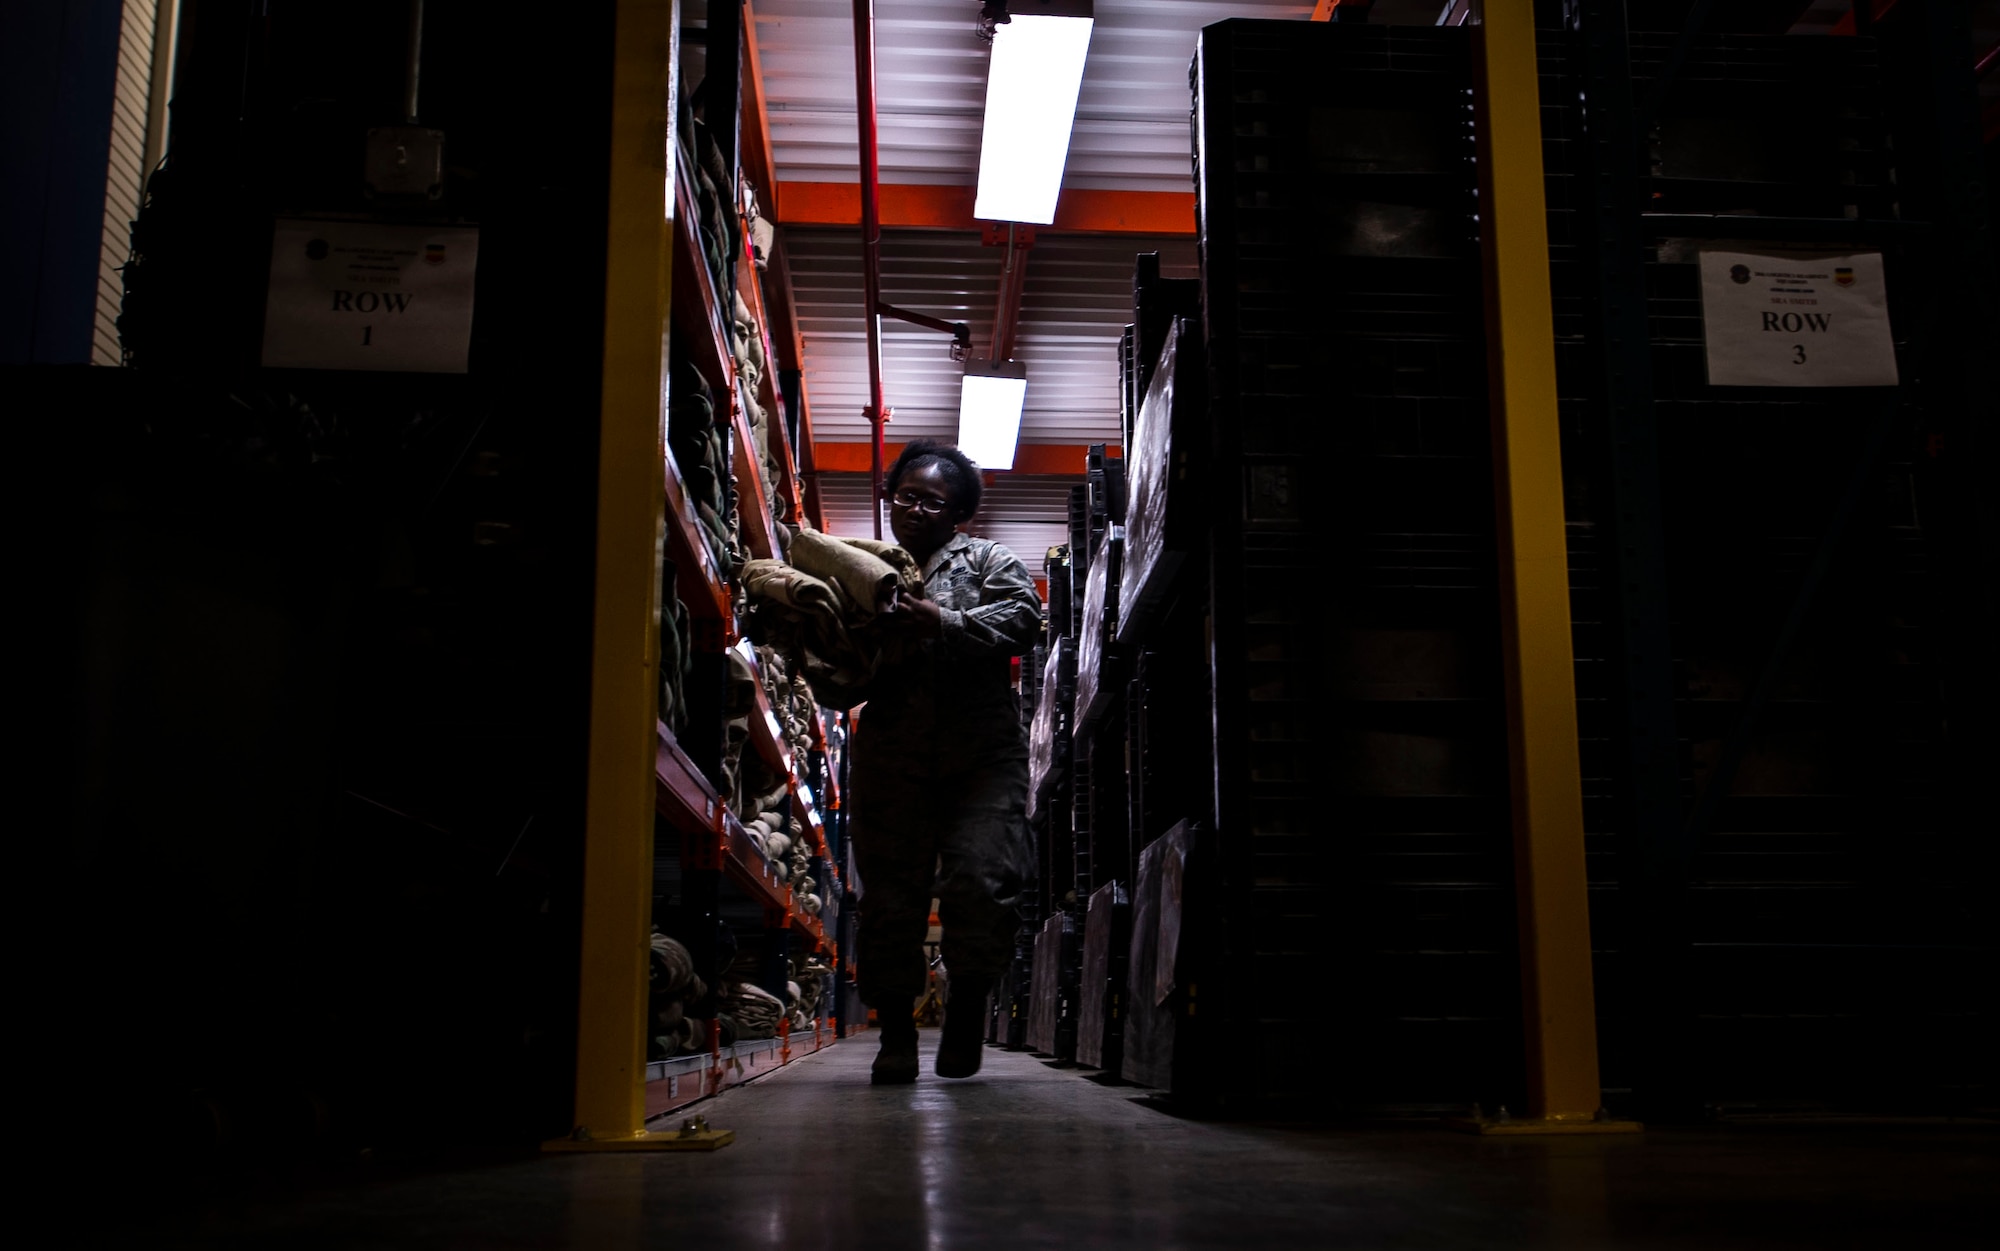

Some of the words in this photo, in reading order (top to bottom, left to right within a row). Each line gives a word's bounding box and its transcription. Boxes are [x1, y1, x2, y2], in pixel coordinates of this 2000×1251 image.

[331, 289, 413, 314] ROW
[1760, 311, 1832, 333] ROW
[360, 325, 373, 346] 1
[1792, 344, 1807, 365] 3
